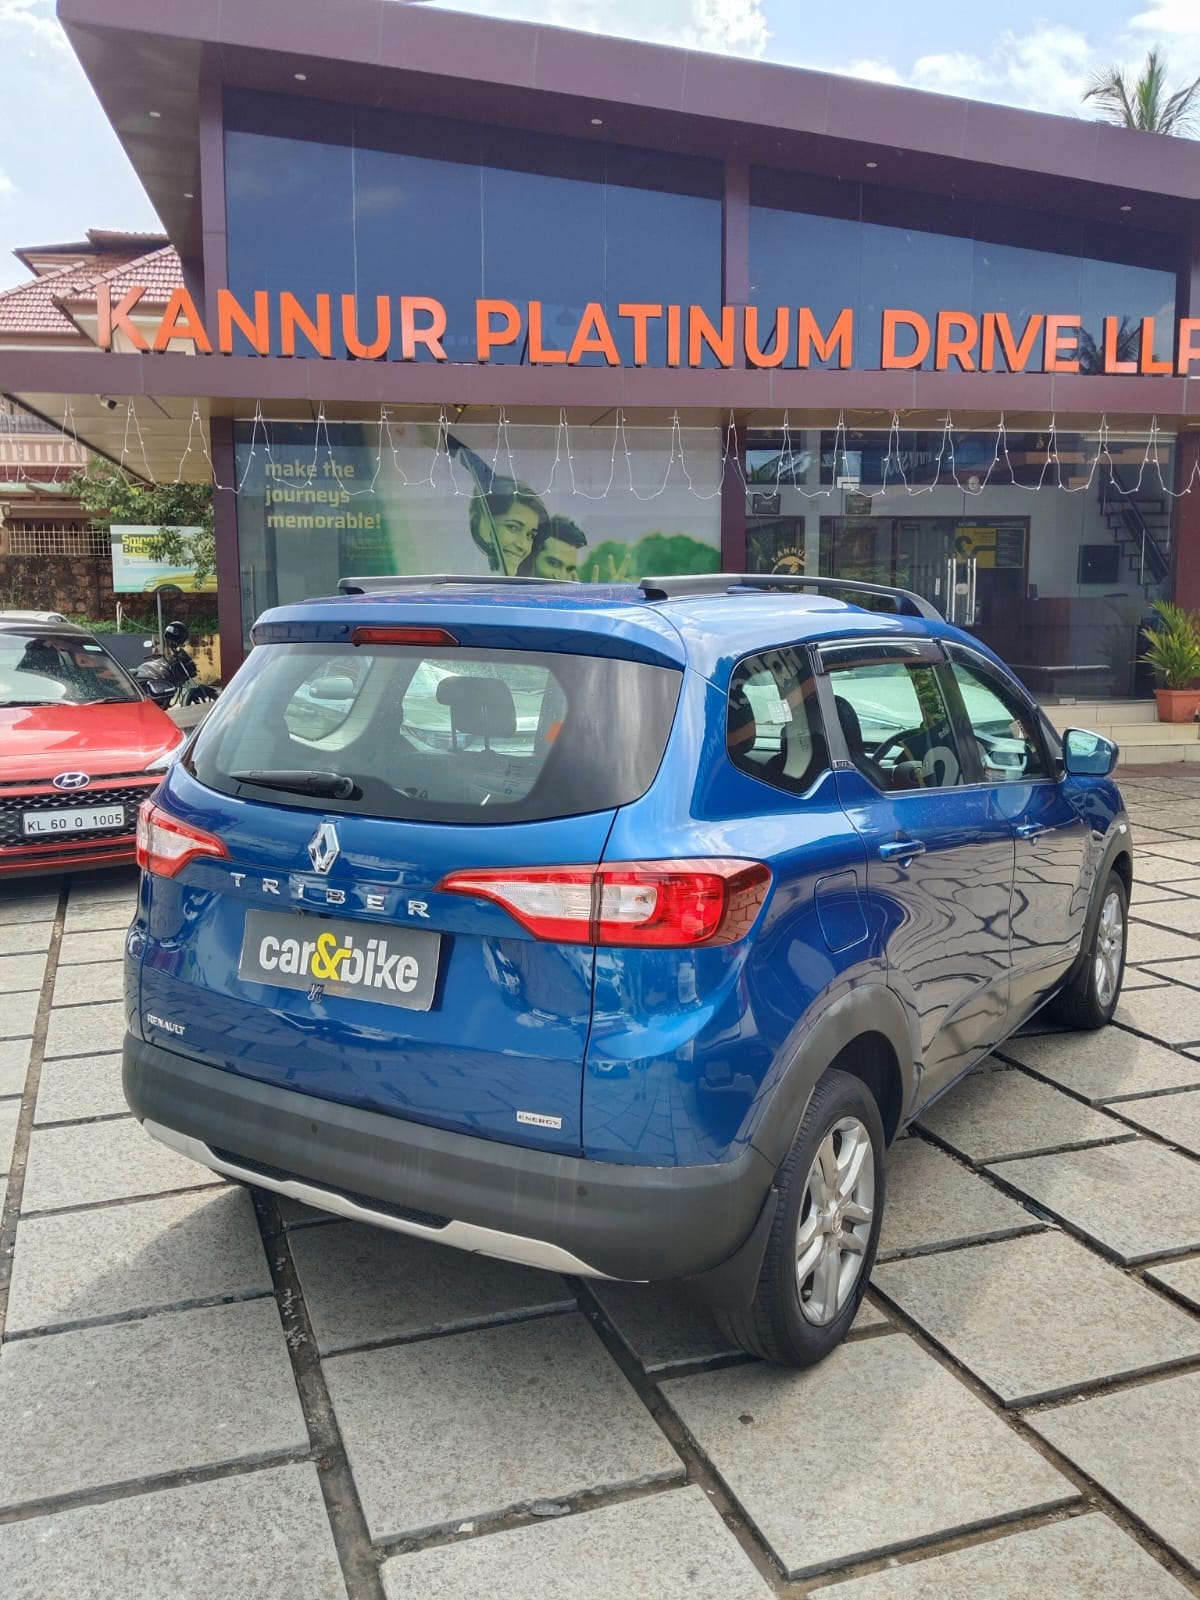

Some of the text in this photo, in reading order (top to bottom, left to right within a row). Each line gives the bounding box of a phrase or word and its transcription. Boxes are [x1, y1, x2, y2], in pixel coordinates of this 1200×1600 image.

[97, 283, 448, 359] KANNUR
[475, 299, 853, 368] PLATINUM
[880, 309, 1082, 373] DRIVE
[264, 459, 355, 478] make the
[264, 484, 350, 508] journeys
[267, 512, 382, 529] memorable!
[27, 820, 46, 832] KL
[50, 818, 67, 830] 60
[92, 813, 123, 827] 1005
[229, 872, 431, 919] TRIBER
[258, 932, 419, 993] car&bike
[147, 1013, 186, 1036] RENAULT
[517, 1113, 561, 1127] ENERGY
